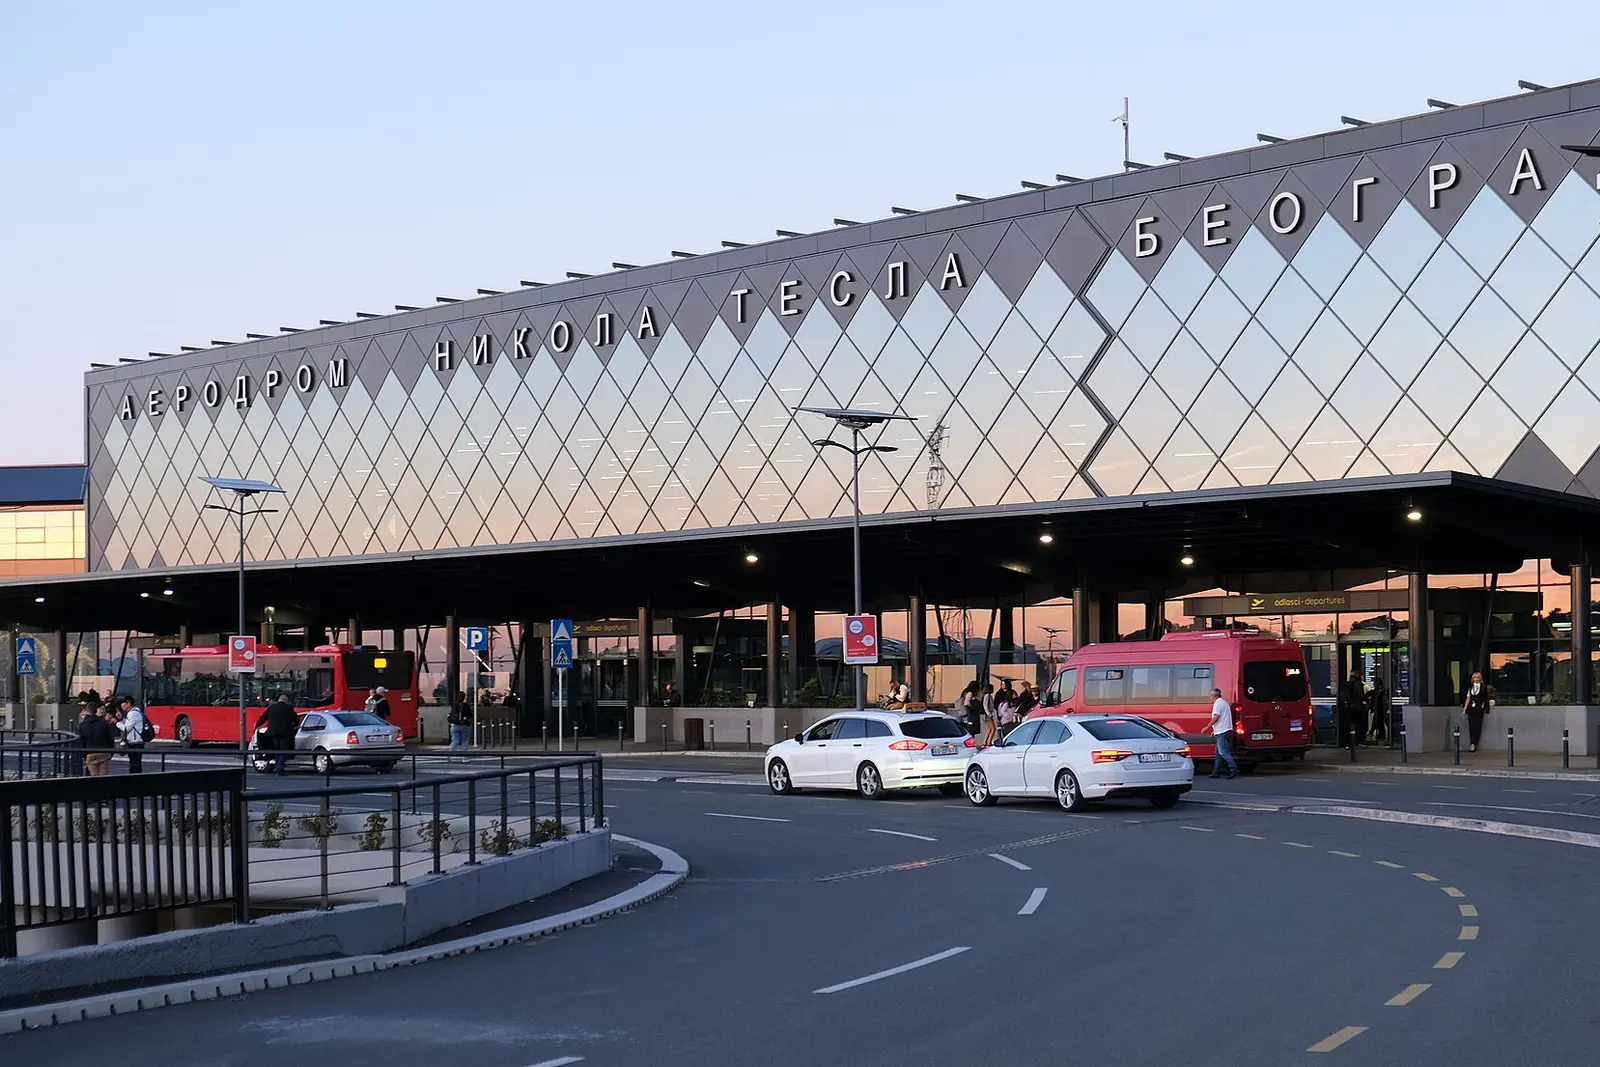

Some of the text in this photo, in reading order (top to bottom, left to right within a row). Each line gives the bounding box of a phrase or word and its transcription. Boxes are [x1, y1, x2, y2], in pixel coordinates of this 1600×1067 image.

[121, 148, 1600, 420] АЕРОДРОМ НИКОЛА ТЕСЛА БЕОГРА
[1274, 596, 1345, 607] odlasci departures
[471, 630, 483, 648] P
